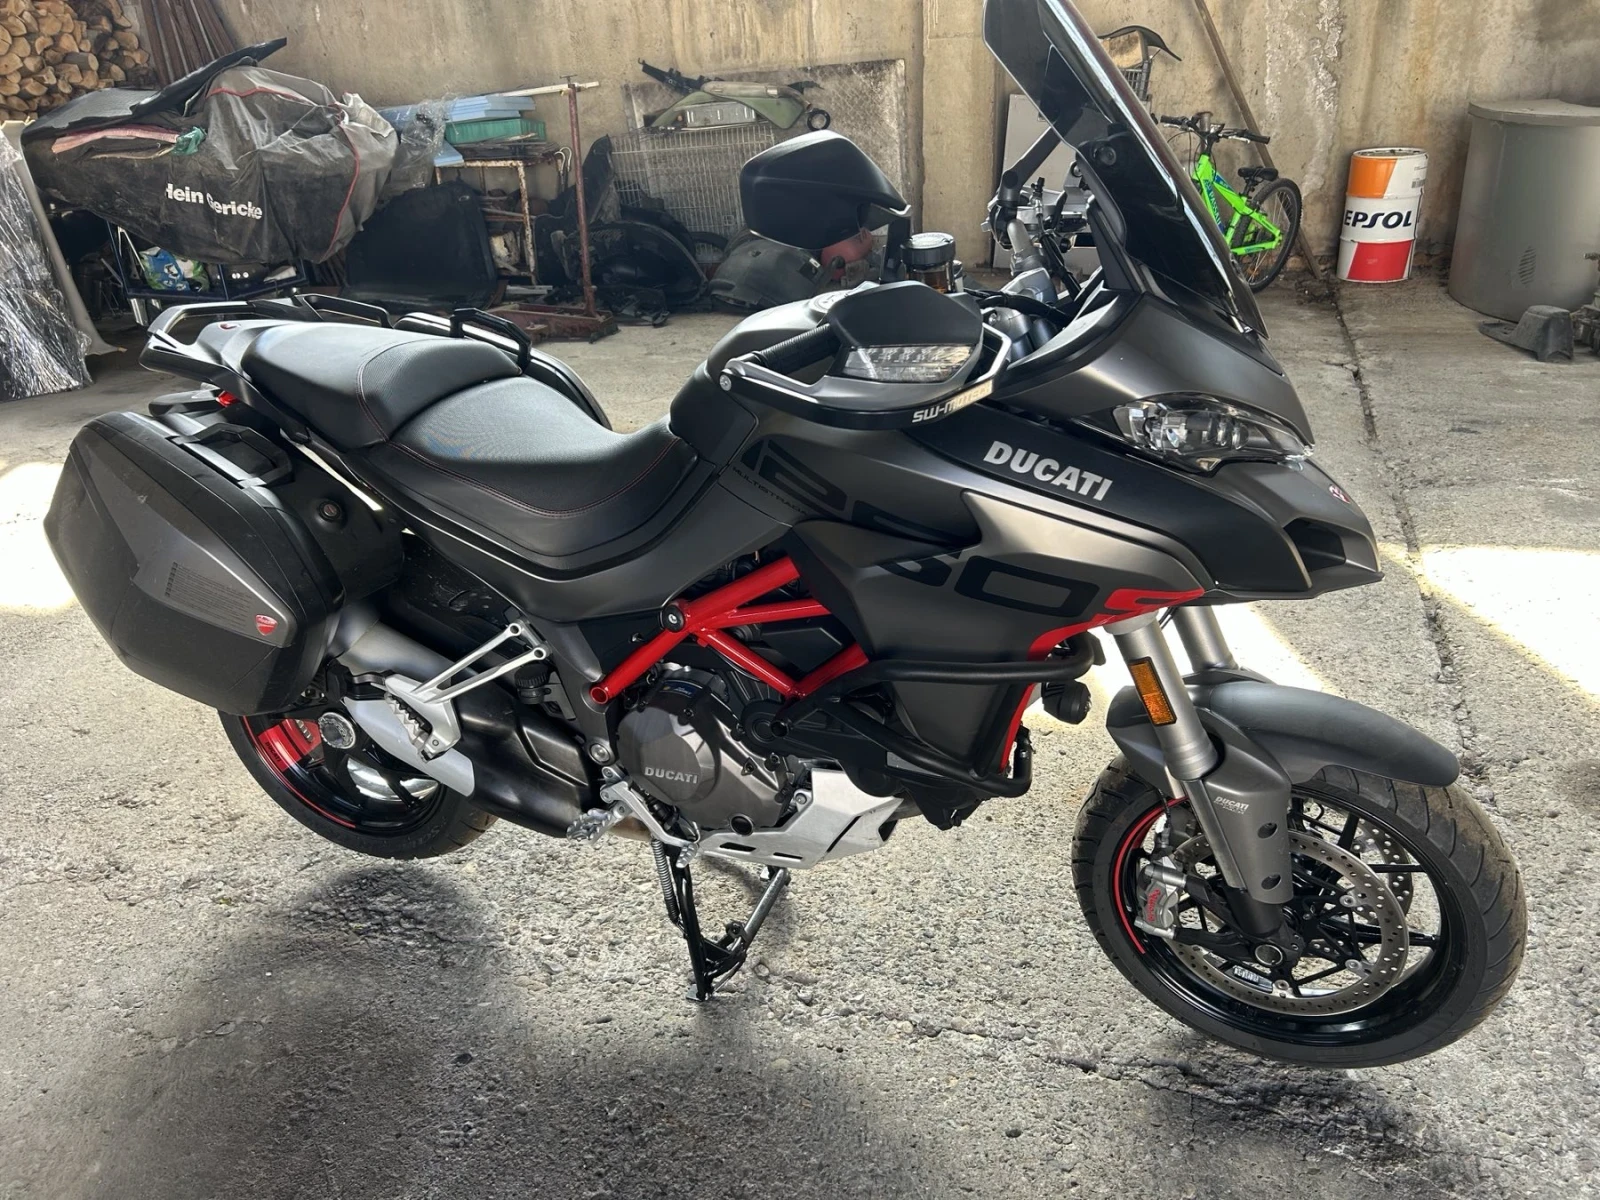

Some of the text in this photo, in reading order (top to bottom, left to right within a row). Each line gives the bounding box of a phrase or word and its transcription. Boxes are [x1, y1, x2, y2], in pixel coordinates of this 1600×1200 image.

[983, 441, 1113, 501] DUCATI
[732, 466, 807, 516] MULTISTRADA
[644, 766, 698, 784] DUCATI
[1214, 796, 1249, 810] DUCATI
